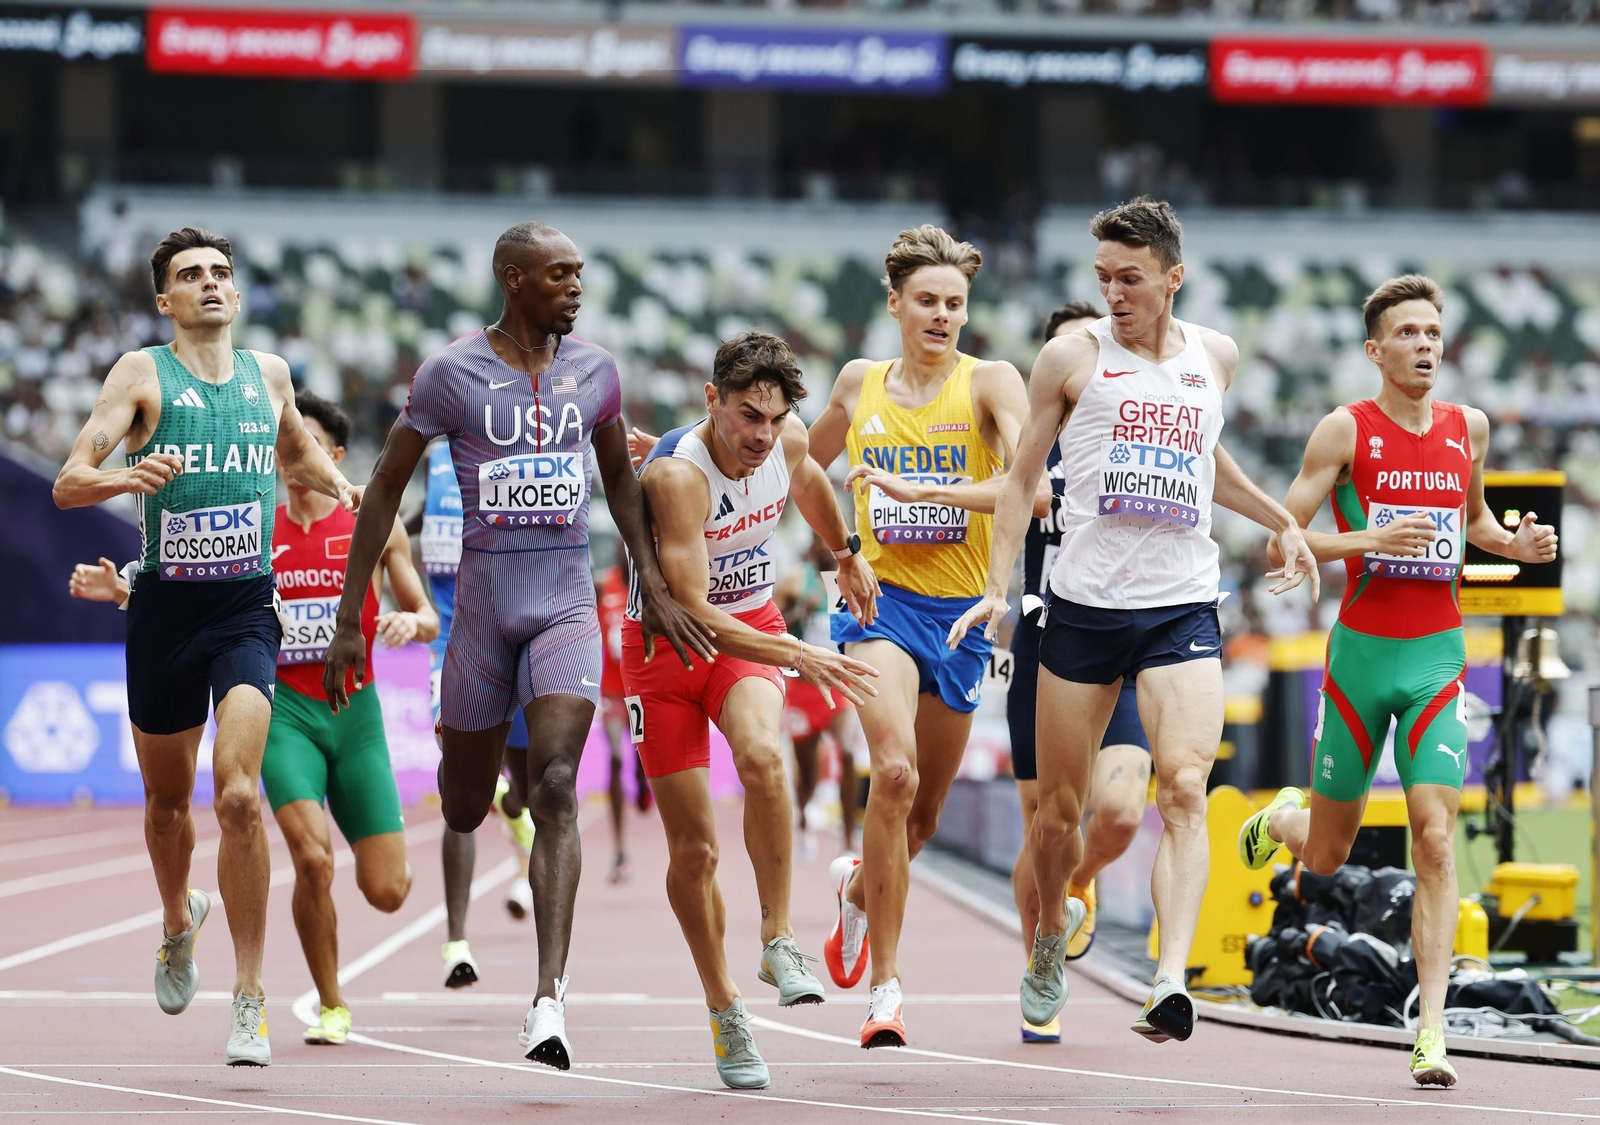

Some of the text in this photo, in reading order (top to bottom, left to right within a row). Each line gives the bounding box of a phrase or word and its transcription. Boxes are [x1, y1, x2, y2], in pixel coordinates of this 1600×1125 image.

[238, 422, 270, 433] 123.ie
[485, 402, 584, 447] USA
[928, 424, 970, 432] BAUHAUS
[1119, 400, 1203, 429] GREAT
[1113, 425, 1204, 455] BRITAIN
[509, 456, 577, 479] TDK
[862, 445, 966, 473] SWEDEN
[1131, 444, 1197, 477] TDK
[1104, 471, 1198, 507] WIGHTMAN
[1376, 470, 1463, 492] PORTUGAL
[185, 506, 255, 532] TDK
[704, 496, 786, 541] FRANCE
[873, 506, 965, 527] PIHLSTROM
[164, 532, 258, 559] COSCORAN
[714, 538, 768, 572] TDK
[275, 568, 345, 590] MOROCC
[709, 561, 771, 592] ORNET
[290, 602, 340, 620] TDK
[990, 654, 1010, 683] 14
